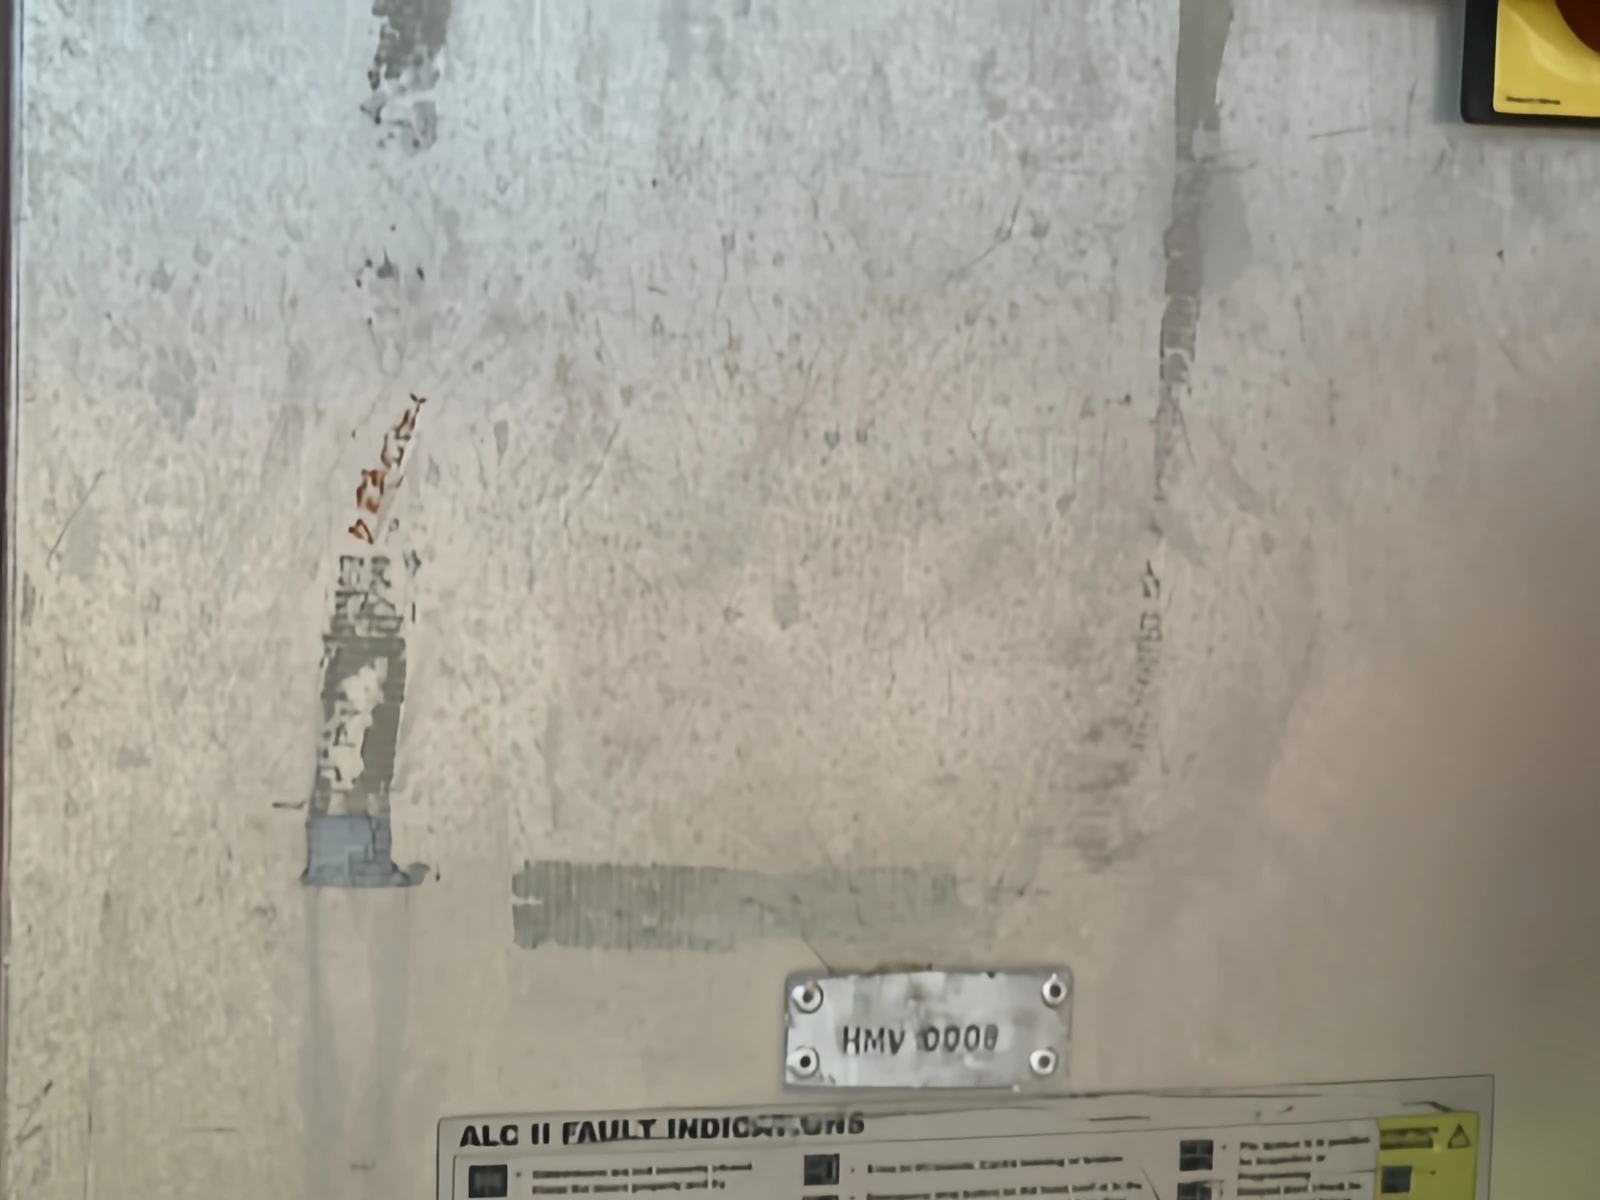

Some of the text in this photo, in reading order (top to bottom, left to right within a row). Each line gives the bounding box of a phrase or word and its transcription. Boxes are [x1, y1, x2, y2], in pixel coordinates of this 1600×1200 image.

[843, 1024, 905, 1055] HMV
[460, 1124, 519, 1148] ALC
[562, 1117, 658, 1145] FAULT
